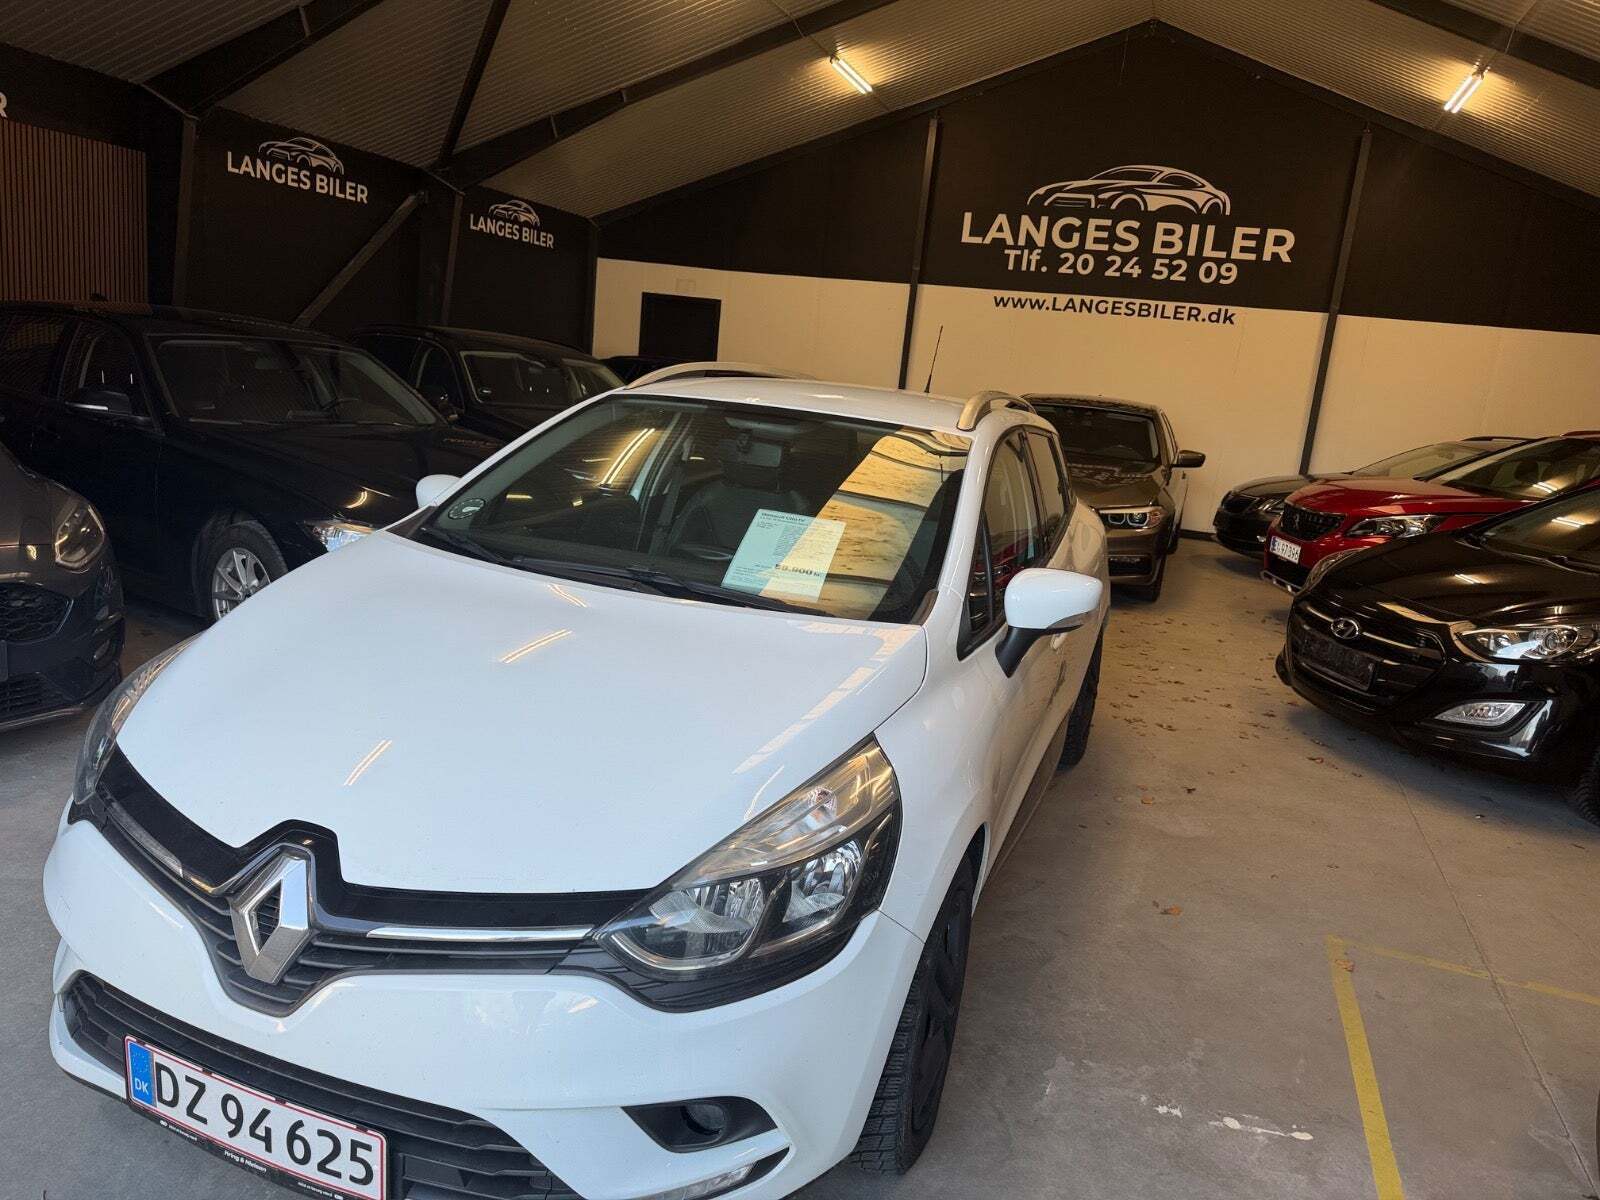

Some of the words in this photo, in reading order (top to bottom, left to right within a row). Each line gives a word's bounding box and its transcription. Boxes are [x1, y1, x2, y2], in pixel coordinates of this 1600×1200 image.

[226, 151, 311, 190] LANGES
[315, 173, 368, 204] BILER
[470, 213, 520, 240] LANGES
[522, 227, 554, 249] BILER
[960, 211, 1141, 253] LANGES
[1152, 221, 1296, 263] BILER
[1004, 248, 1047, 272] Tlf.
[1057, 252, 1095, 276] 20
[1104, 254, 1142, 278] 24
[1151, 258, 1187, 282] 52
[1198, 261, 1239, 285] 09
[993, 295, 1235, 325] www.LANGESBILER.dk
[134, 1077, 149, 1095] DK
[156, 1061, 208, 1125] DZ
[220, 1093, 273, 1154] 94
[286, 1119, 375, 1186] 625
